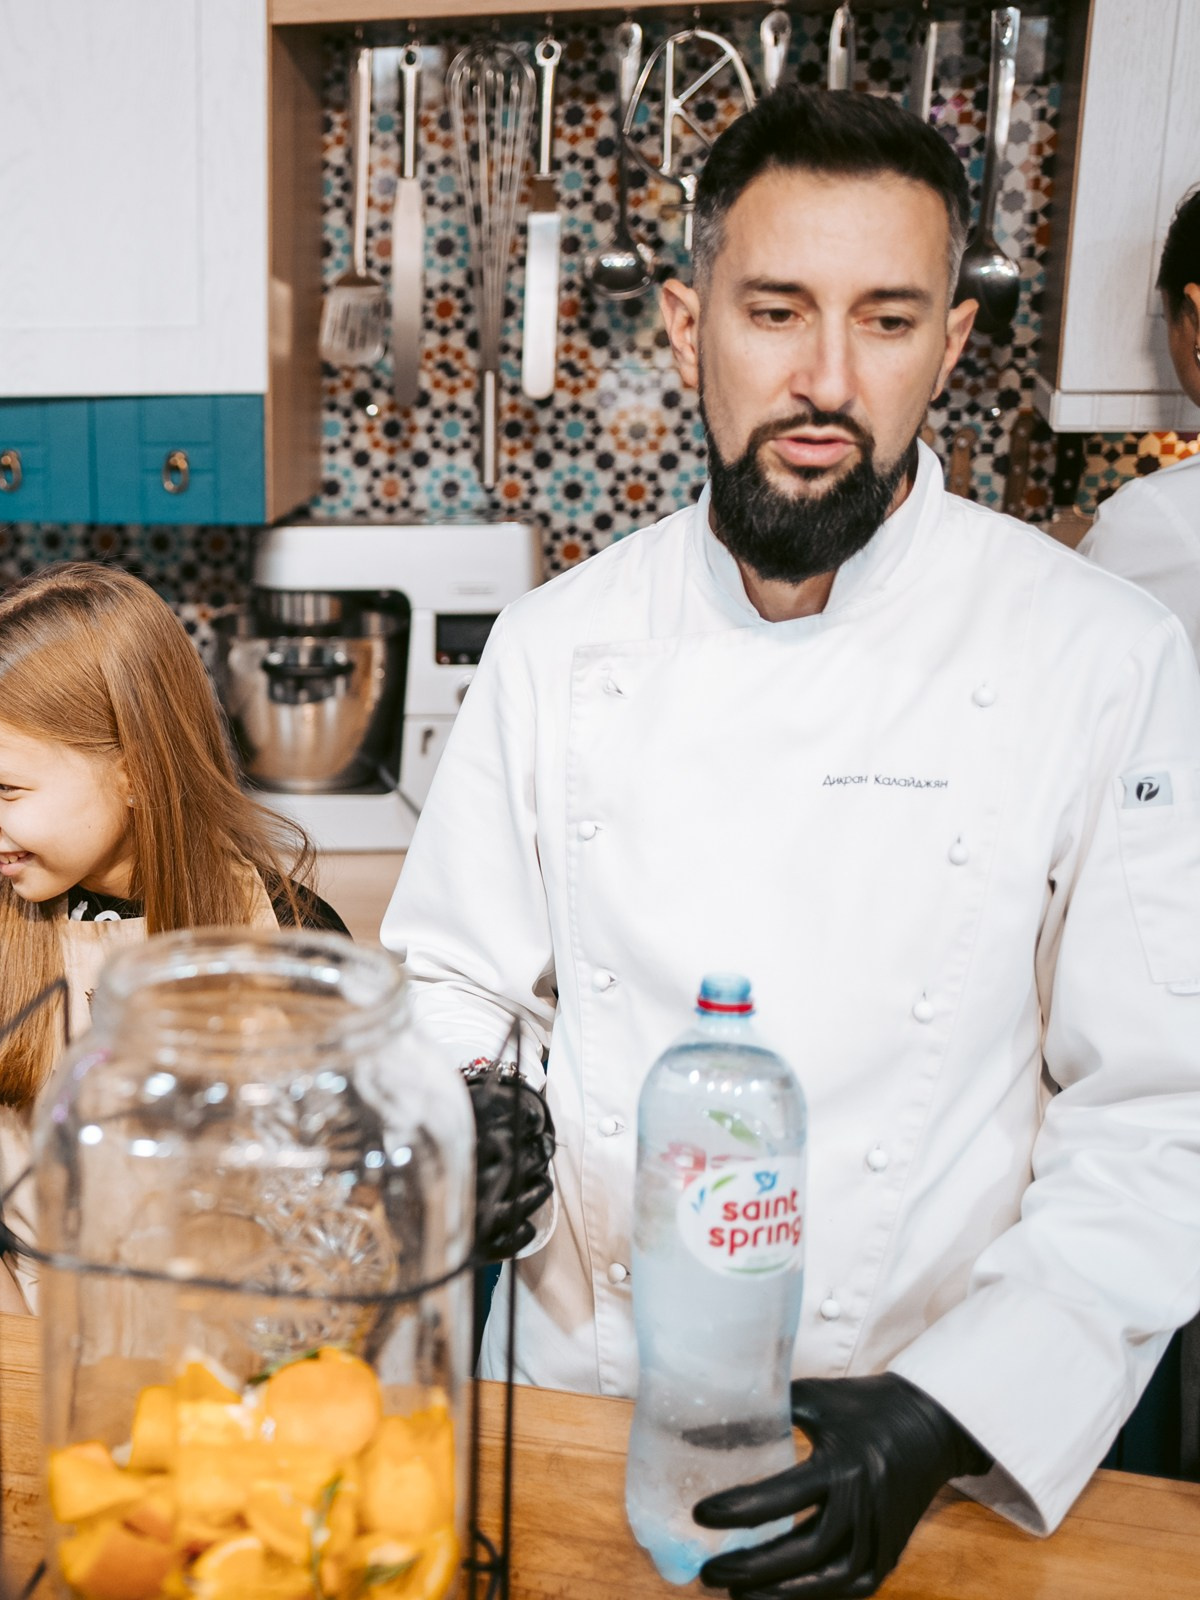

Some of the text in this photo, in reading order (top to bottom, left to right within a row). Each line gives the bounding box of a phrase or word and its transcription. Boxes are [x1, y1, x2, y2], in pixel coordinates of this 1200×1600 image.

[822, 774, 949, 789] Дикран Калайджян
[722, 1187, 798, 1222] saint
[708, 1215, 803, 1257] spring
